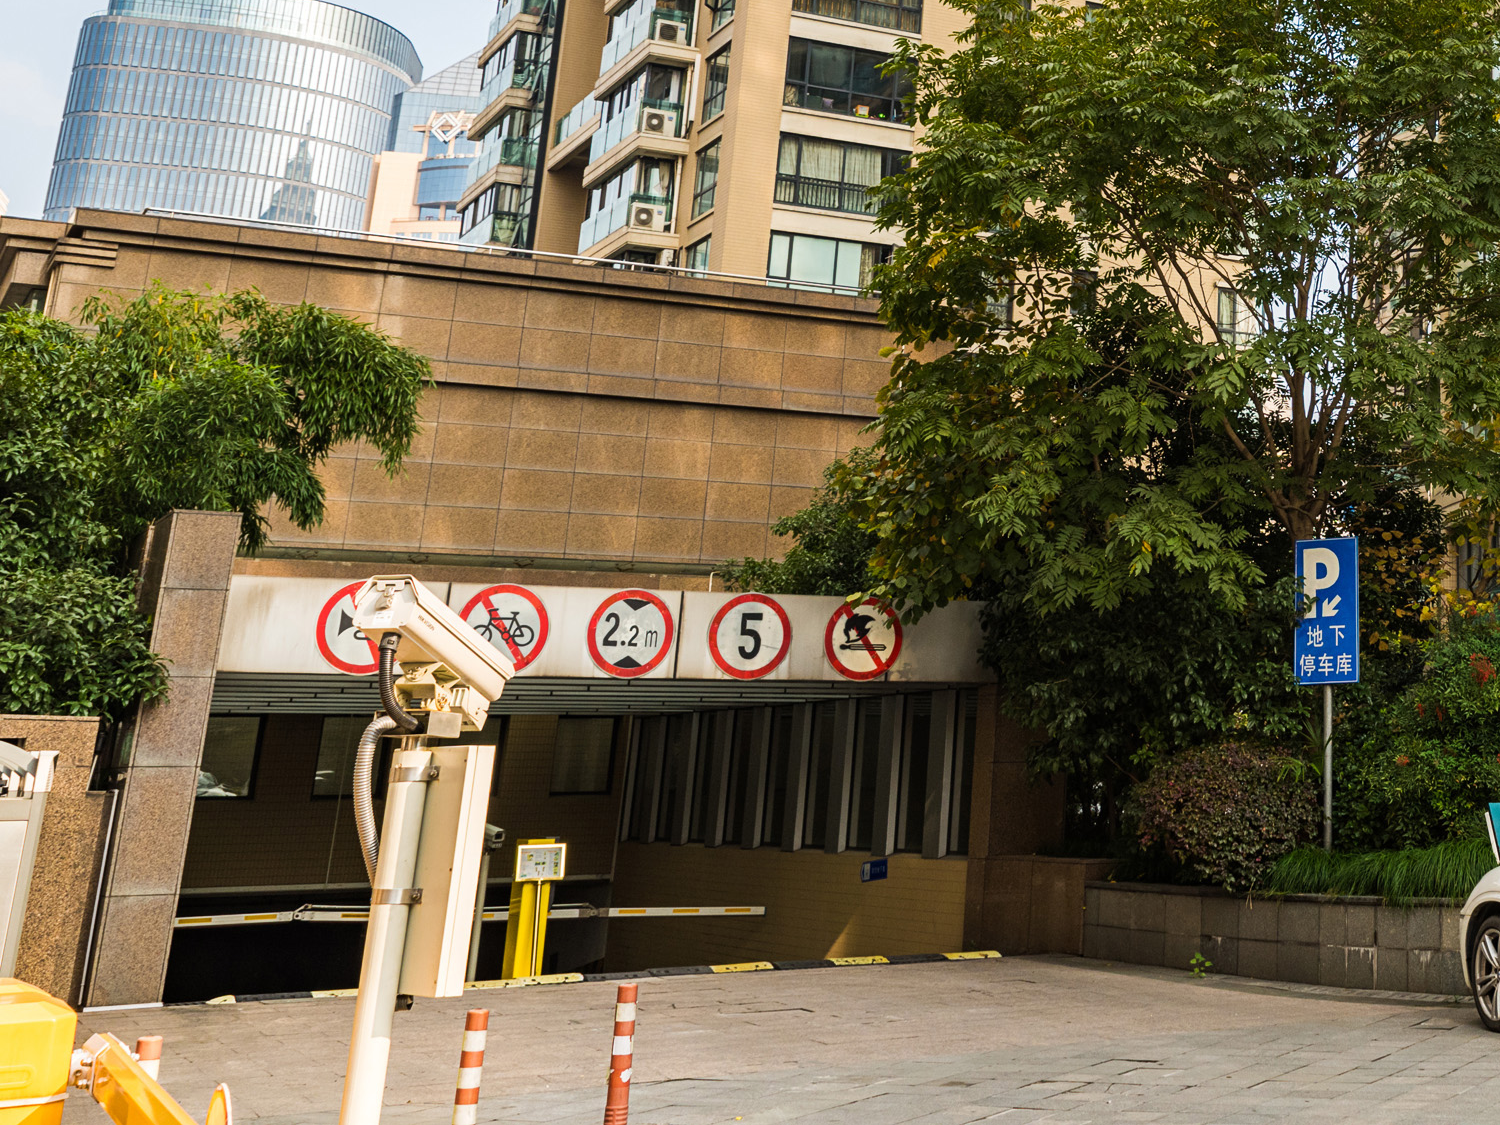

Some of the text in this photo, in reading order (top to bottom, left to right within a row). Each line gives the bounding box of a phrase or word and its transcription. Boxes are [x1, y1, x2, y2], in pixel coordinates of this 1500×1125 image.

[1302, 547, 1340, 619] P
[738, 613, 763, 660] 5
[1306, 625, 1346, 648] 地下
[1299, 652, 1352, 677] 停车库
